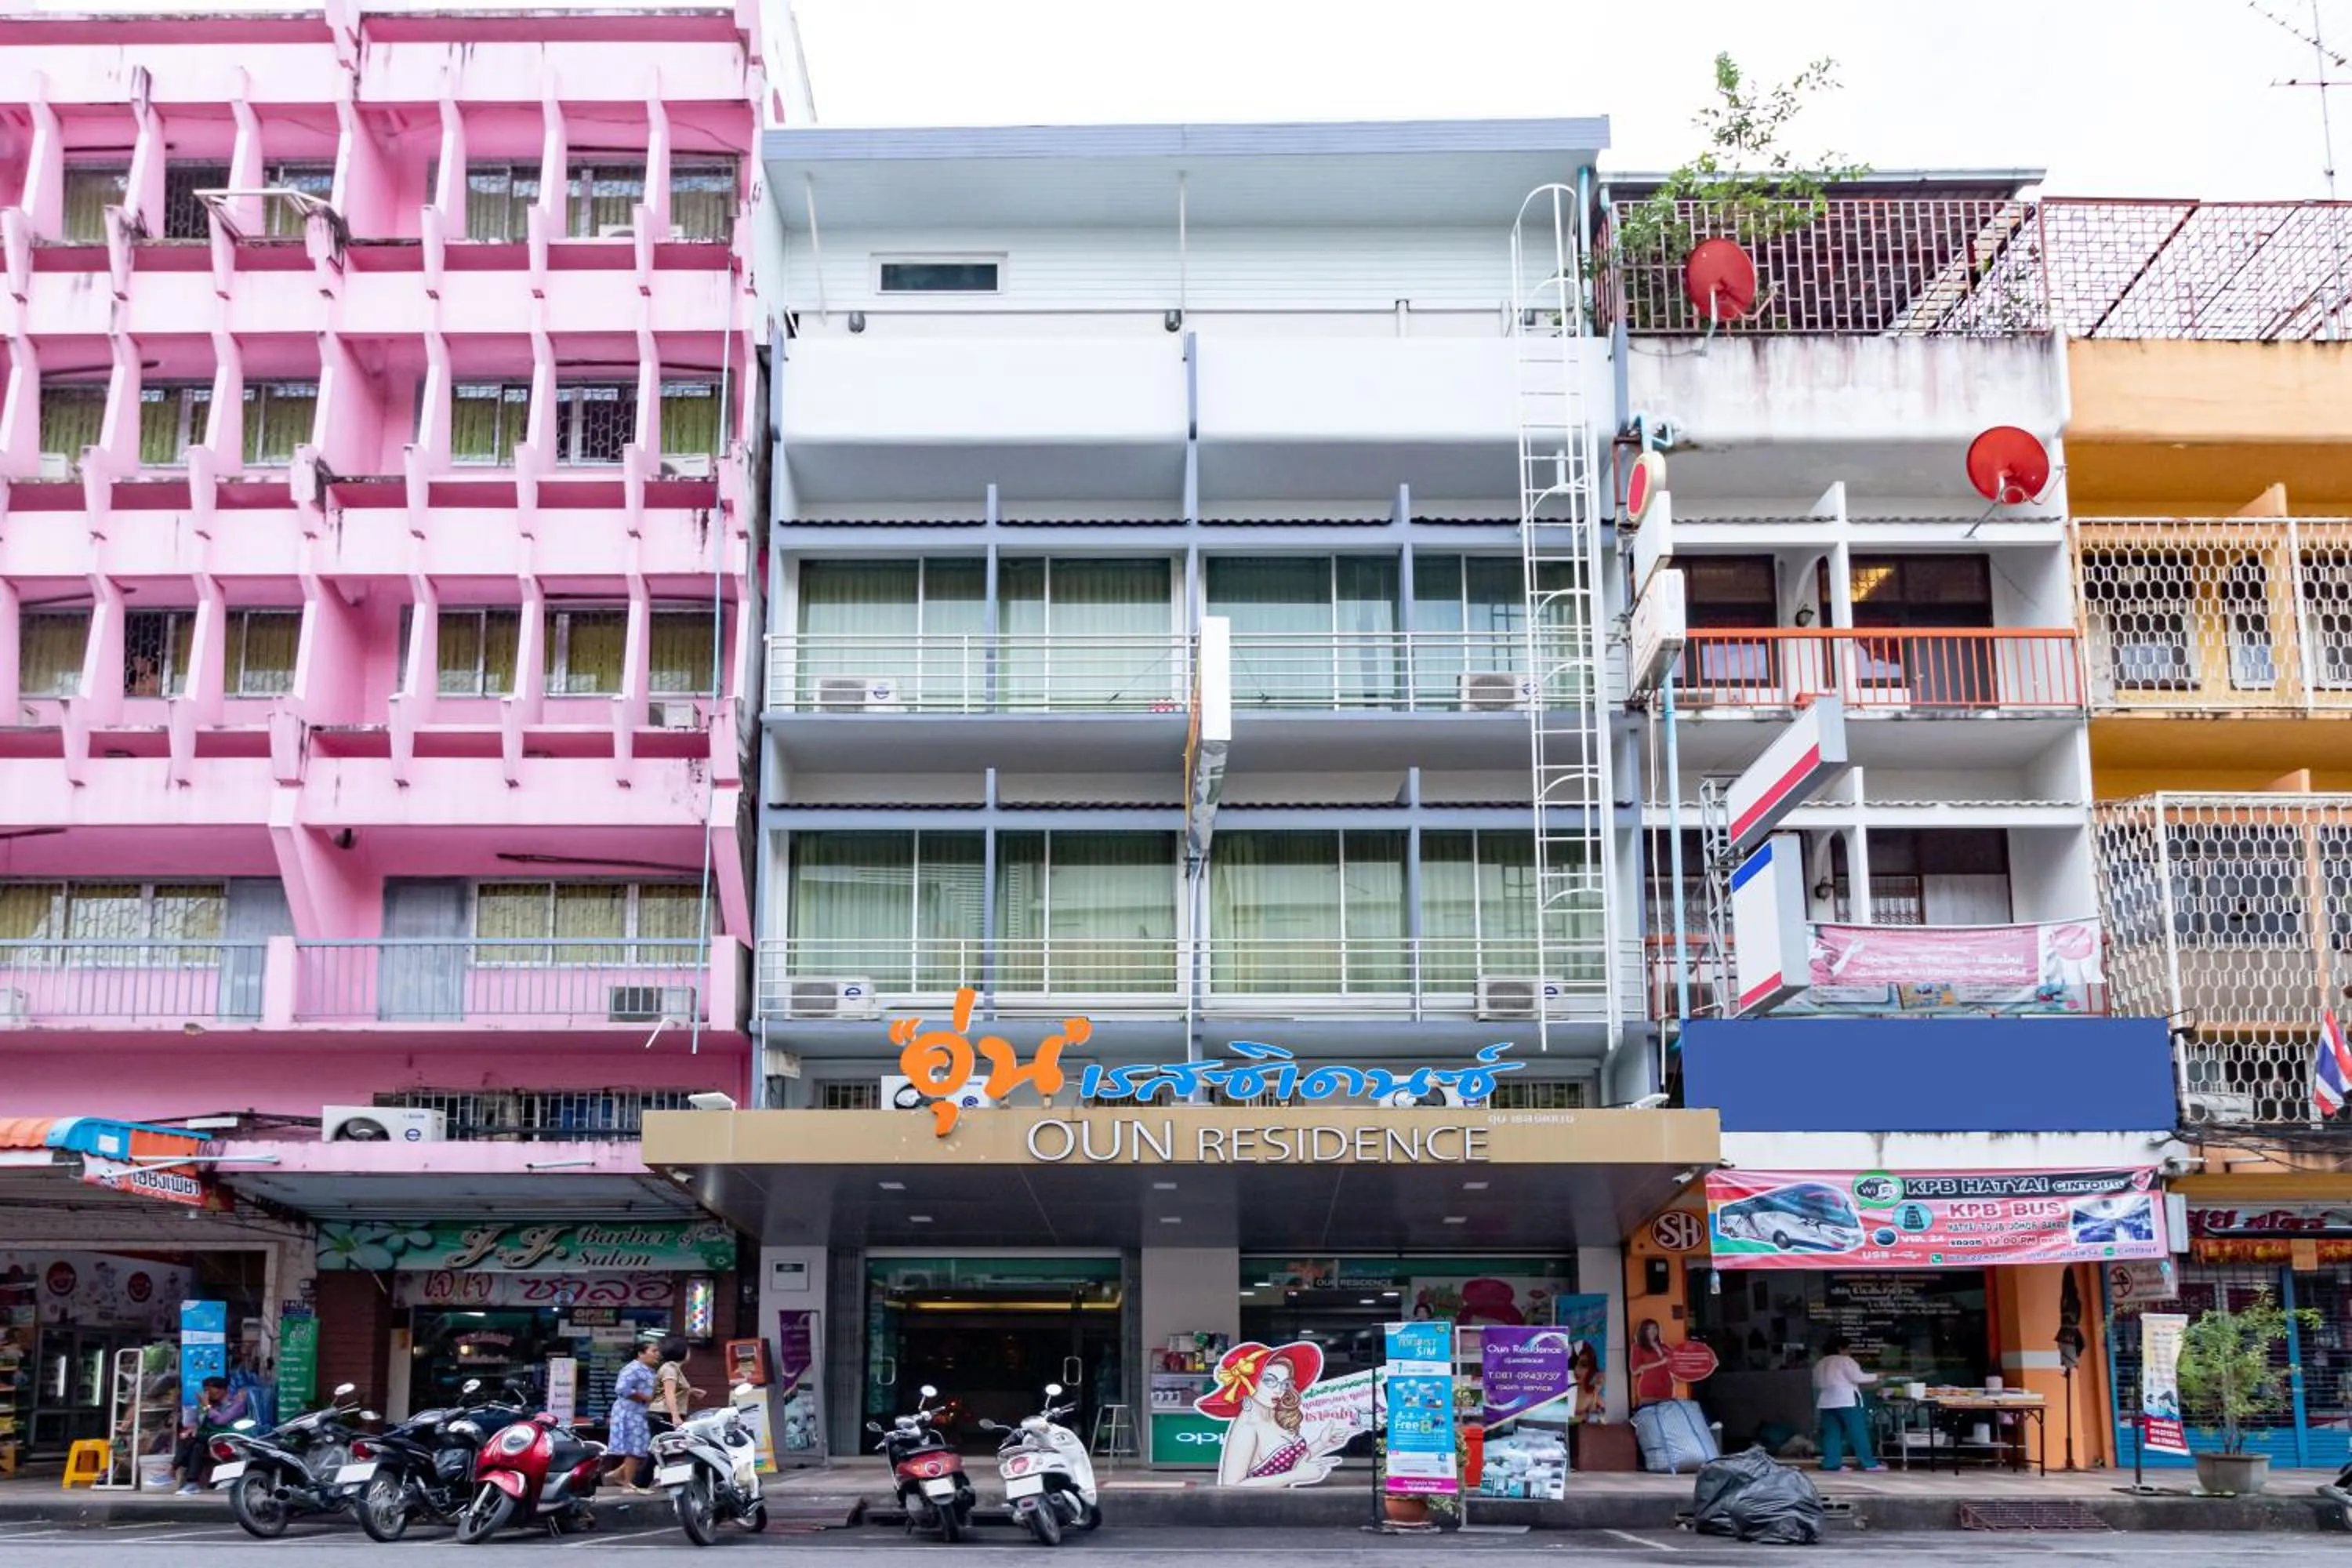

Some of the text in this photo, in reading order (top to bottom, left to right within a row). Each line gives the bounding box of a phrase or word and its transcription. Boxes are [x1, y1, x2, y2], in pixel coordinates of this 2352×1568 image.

[1027, 1119, 1489, 1163] OUN RESIDENCE
[1906, 1178, 1958, 1196] KPB
[1961, 1177, 2049, 1194] HATYAI
[1948, 1200, 2063, 1218] KPB BUS
[577, 1223, 671, 1247] Barber
[1657, 1211, 1700, 1250] SH
[578, 1248, 652, 1267] Salon
[1512, 1344, 1563, 1354] Residence
[1396, 1420, 1420, 1430] Free
[1176, 1432, 1225, 1445] op
